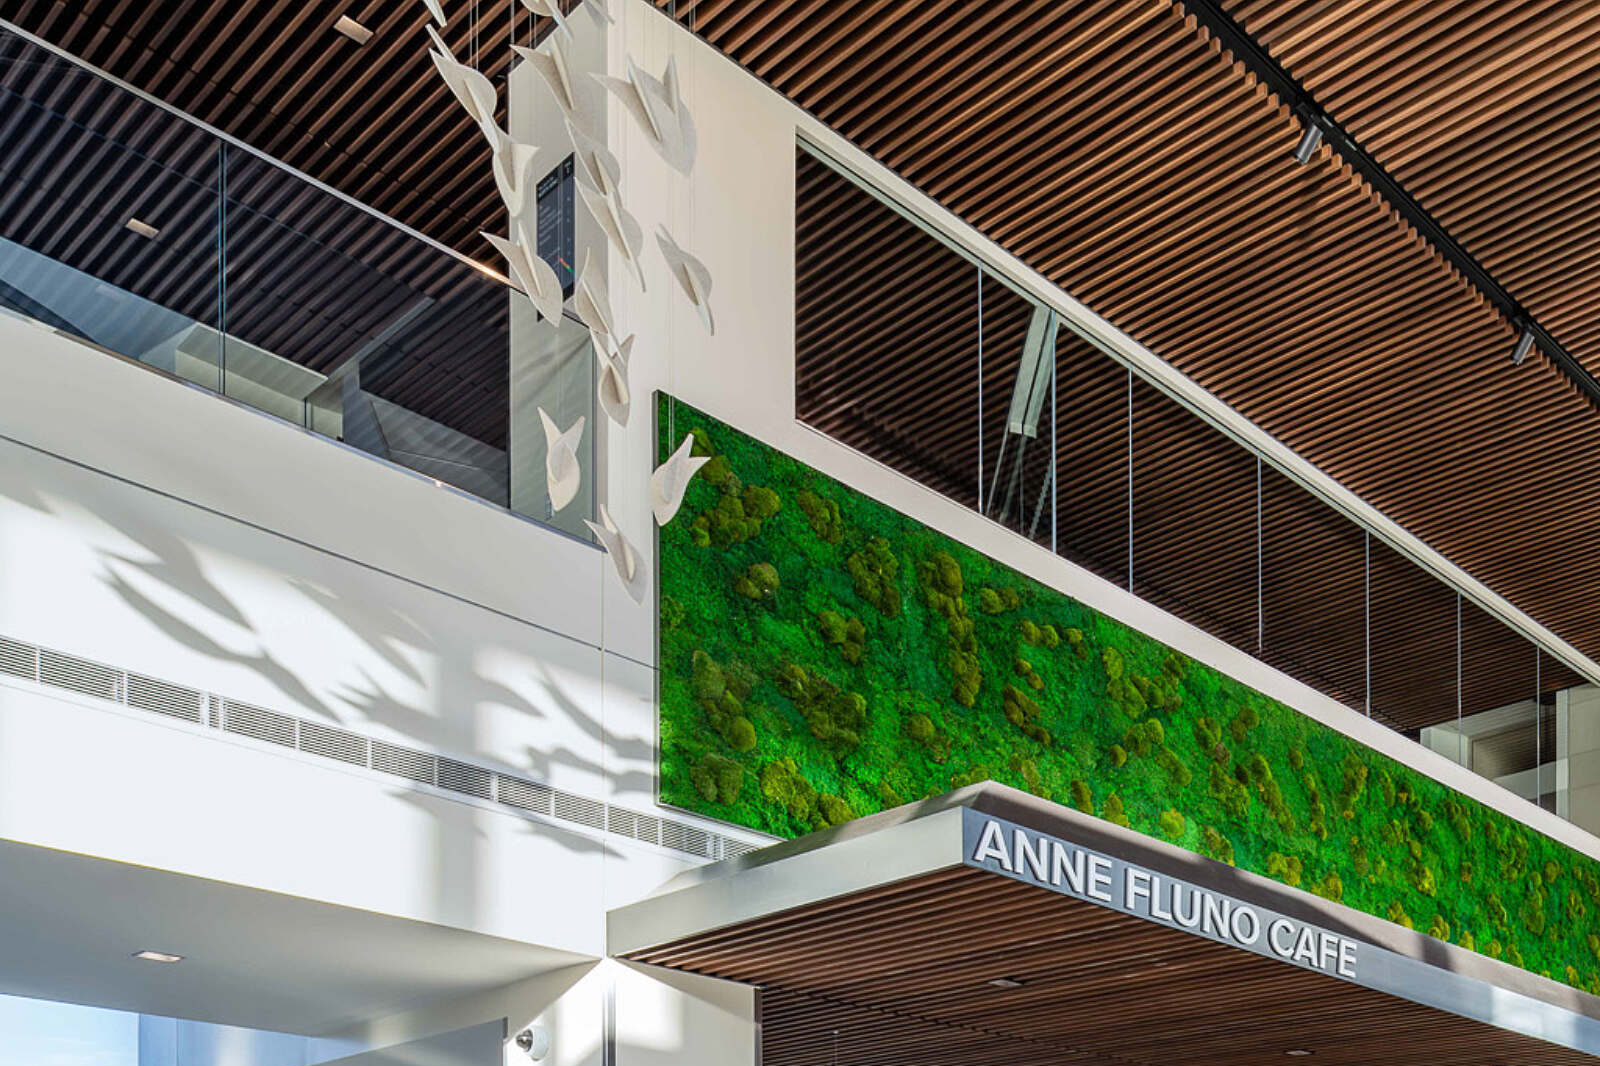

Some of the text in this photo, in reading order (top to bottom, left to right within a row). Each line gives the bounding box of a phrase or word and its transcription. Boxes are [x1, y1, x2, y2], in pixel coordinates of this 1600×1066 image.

[974, 820, 1357, 978] ANNE FLUNO CAFE
